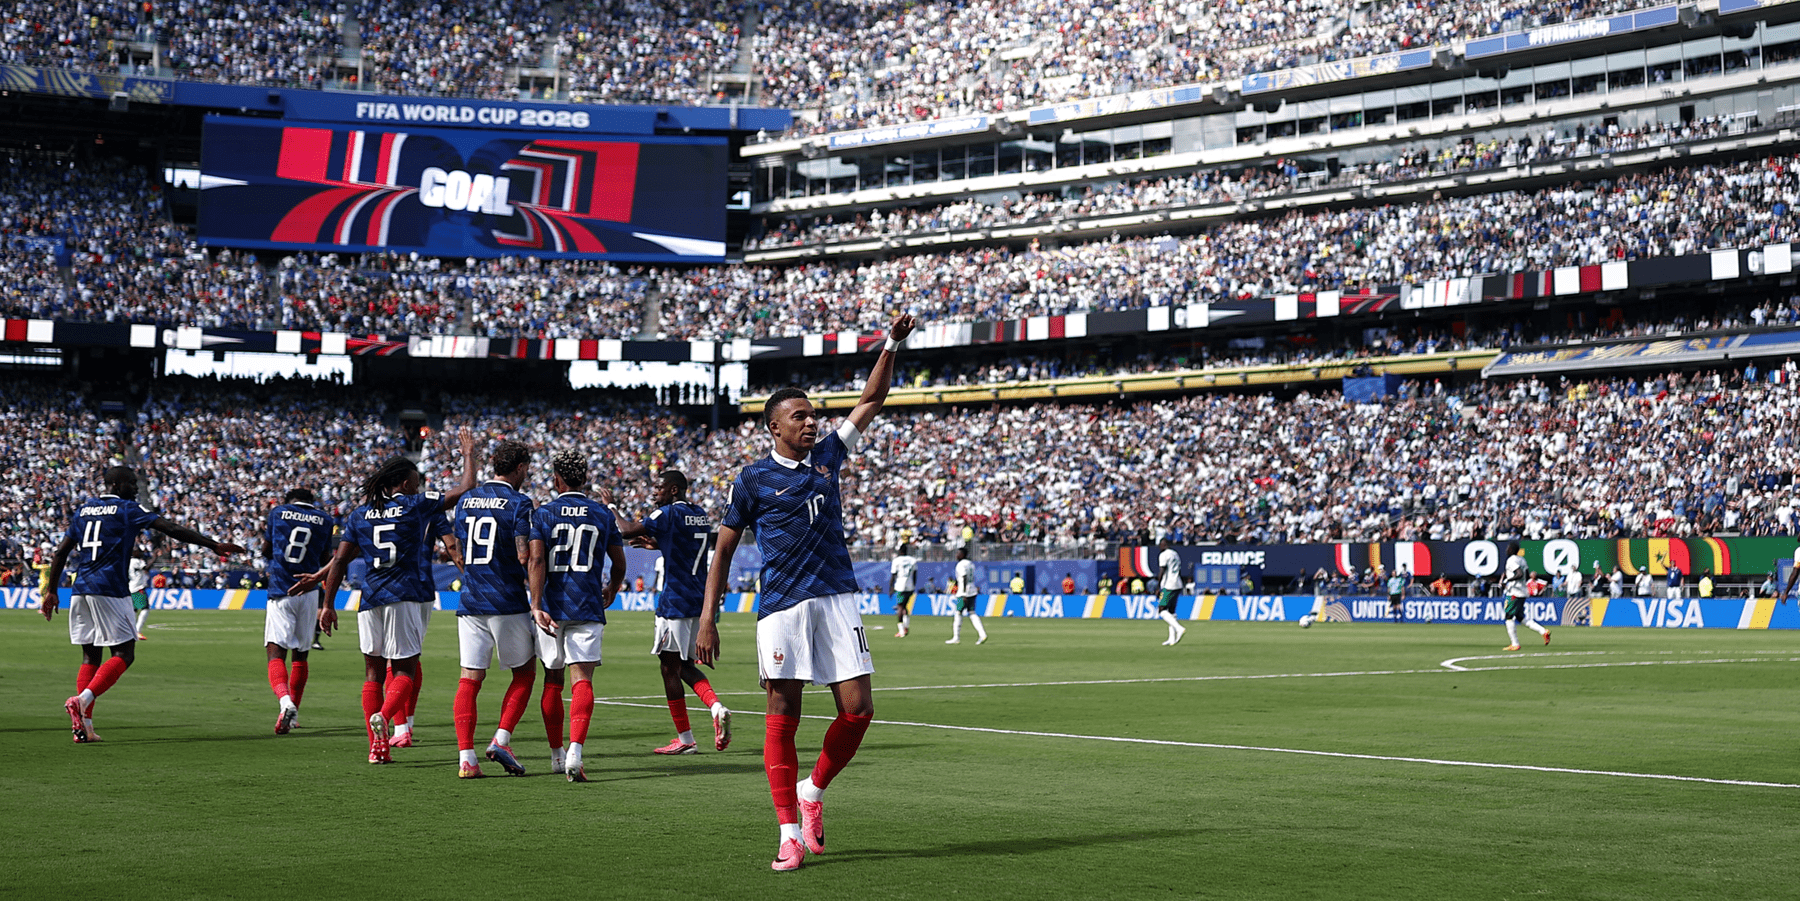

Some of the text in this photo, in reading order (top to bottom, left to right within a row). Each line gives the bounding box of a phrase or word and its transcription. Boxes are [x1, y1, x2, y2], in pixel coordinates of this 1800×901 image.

[356, 102, 590, 129] FIFA WORLD CUP 2026
[419, 167, 514, 217] GOAL
[560, 506, 589, 517] DOUE
[82, 520, 102, 561] 4
[284, 526, 312, 564] 8
[372, 523, 397, 569] 5
[465, 516, 498, 565] 19
[549, 522, 599, 573] 20
[692, 532, 708, 576] 7
[1201, 551, 1266, 569] FRANCE
[1, 587, 43, 609] VIS
[620, 591, 656, 611] VISA
[1019, 595, 1064, 618] VISA
[1232, 596, 1286, 621] VISA
[1405, 601, 1460, 620] STATES
[1461, 601, 1482, 620] OF
[1631, 598, 1704, 628] VISA
